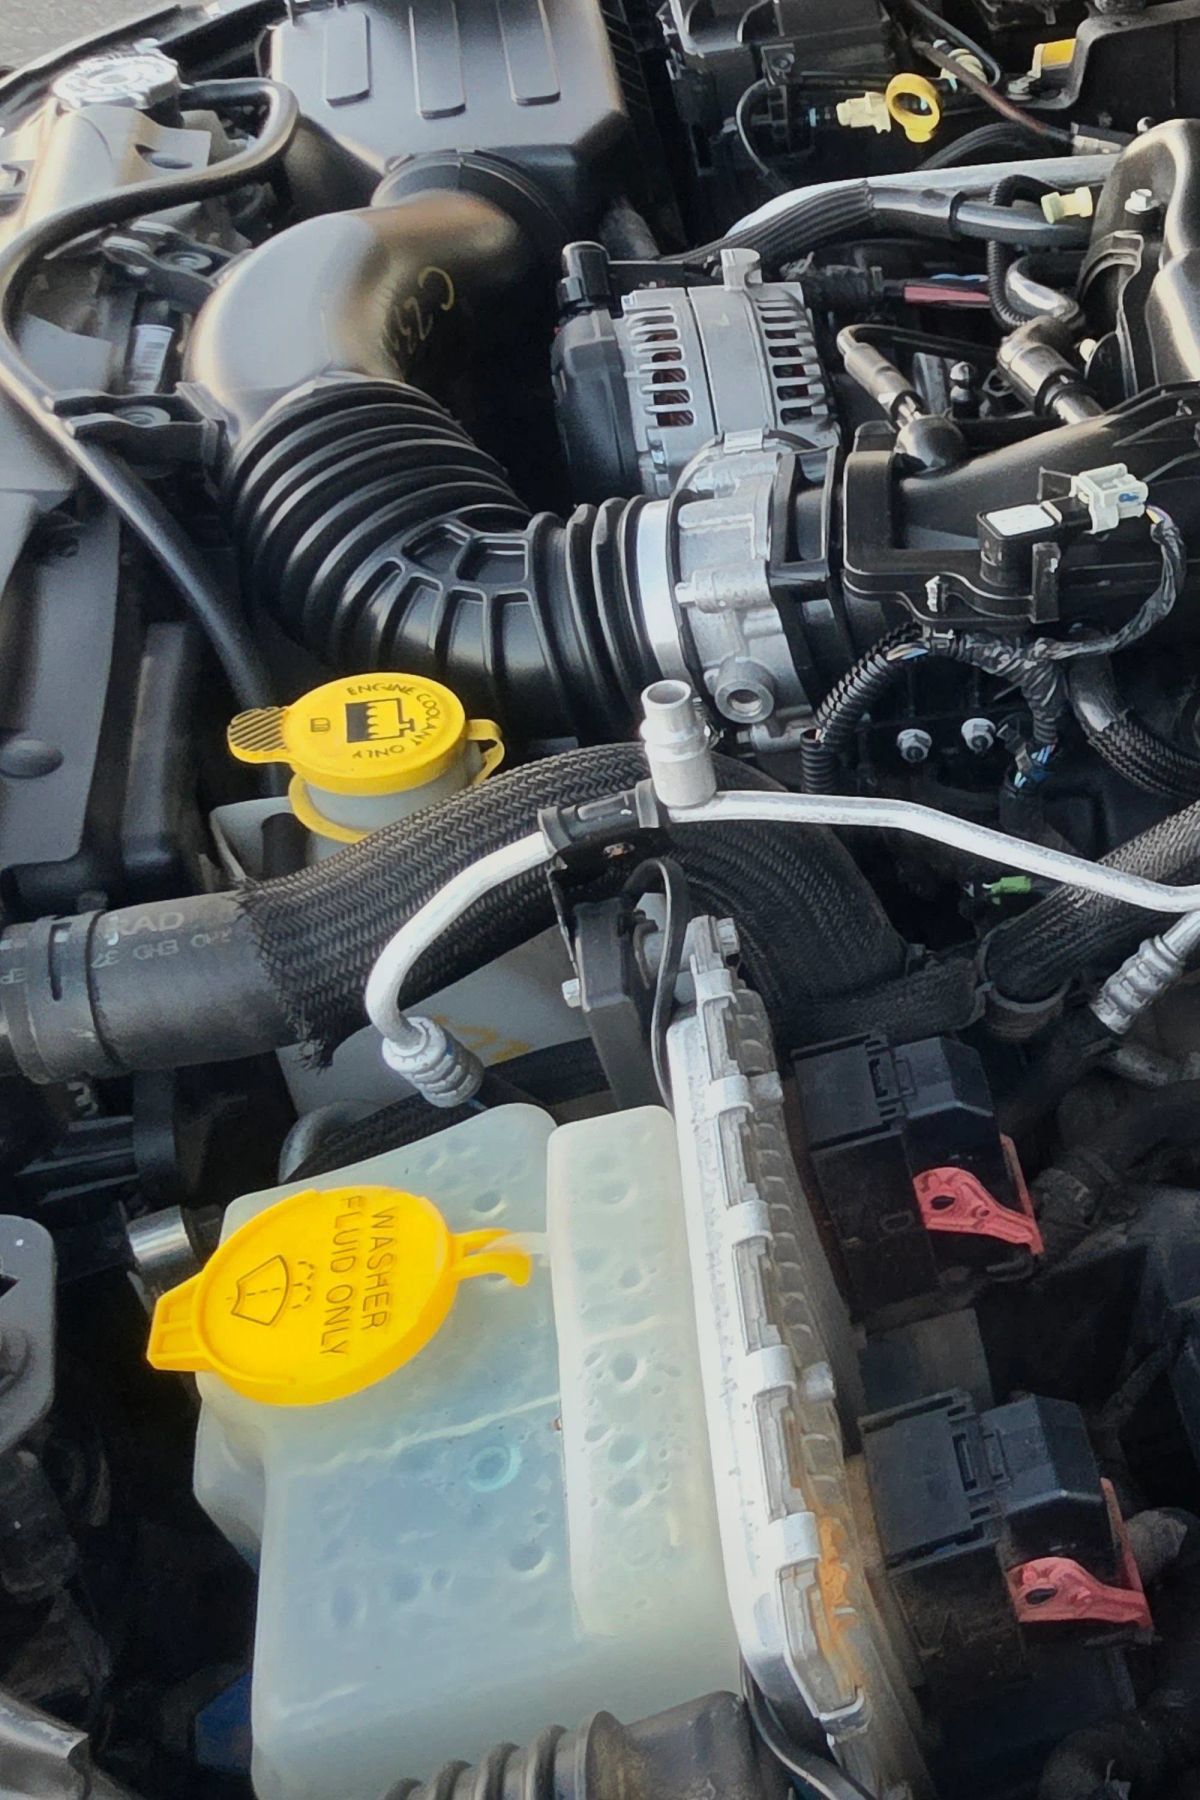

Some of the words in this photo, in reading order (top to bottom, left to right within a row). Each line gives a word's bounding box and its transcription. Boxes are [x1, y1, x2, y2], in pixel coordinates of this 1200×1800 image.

[346, 683, 415, 696] ENGINE
[410, 693, 441, 746] COOLANT
[351, 744, 405, 759] ONLY
[330, 1195, 364, 1274] FLUID
[360, 1206, 399, 1331] WASHER
[319, 1283, 354, 1355] ONLY
